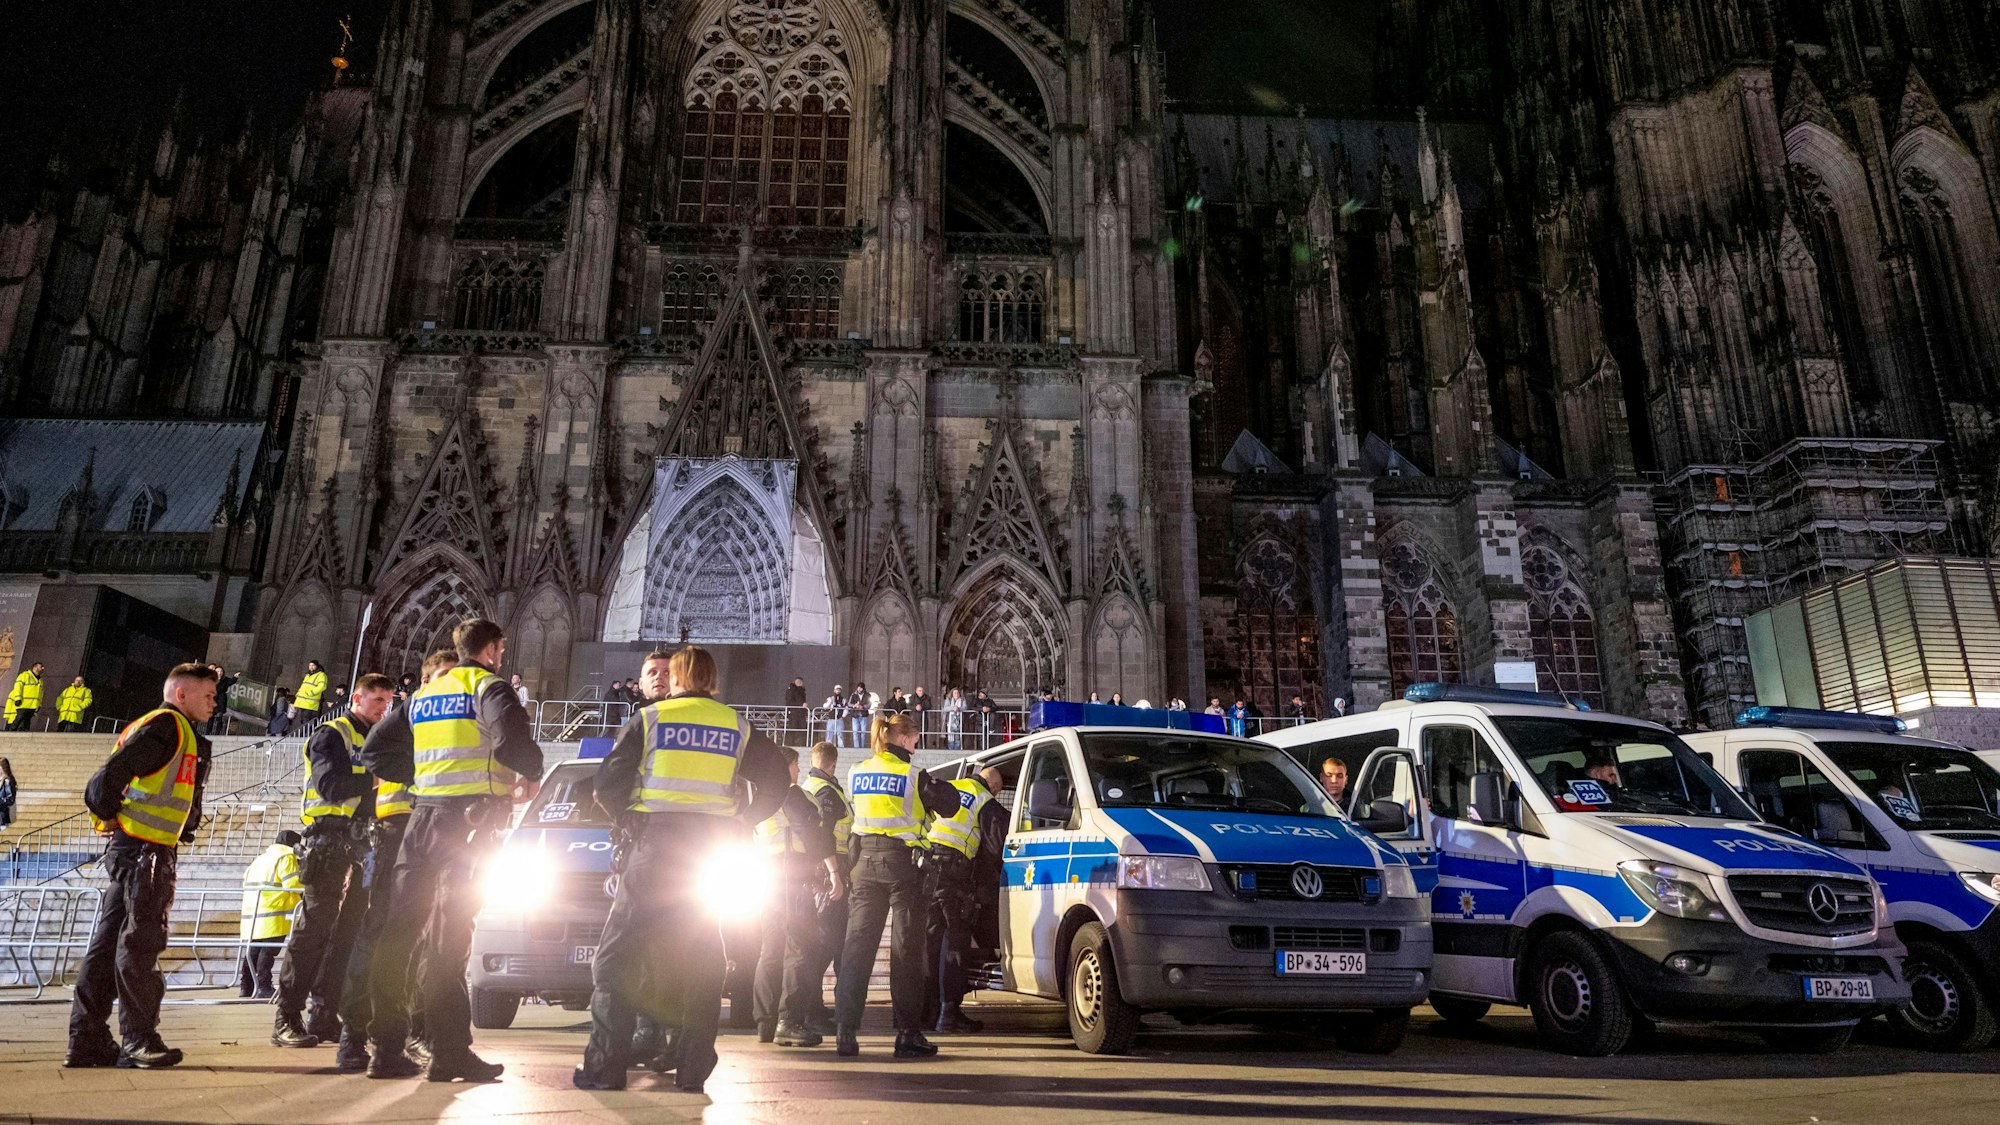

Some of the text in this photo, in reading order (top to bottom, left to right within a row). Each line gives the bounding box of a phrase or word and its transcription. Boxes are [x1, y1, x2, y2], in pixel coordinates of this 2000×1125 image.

[413, 696, 471, 720] POLIZEI
[664, 727, 735, 752] POLIZEI
[854, 775, 902, 793] POLIZEI
[1574, 783, 1599, 791] STA
[1581, 792, 1605, 801] 224
[1210, 823, 1340, 840] POLIZEI
[567, 841, 617, 852] PO
[575, 947, 595, 962] BP
[1287, 953, 1363, 972] BP 34-596
[1815, 980, 1832, 996] BP
[1840, 980, 1871, 997] 29-81
